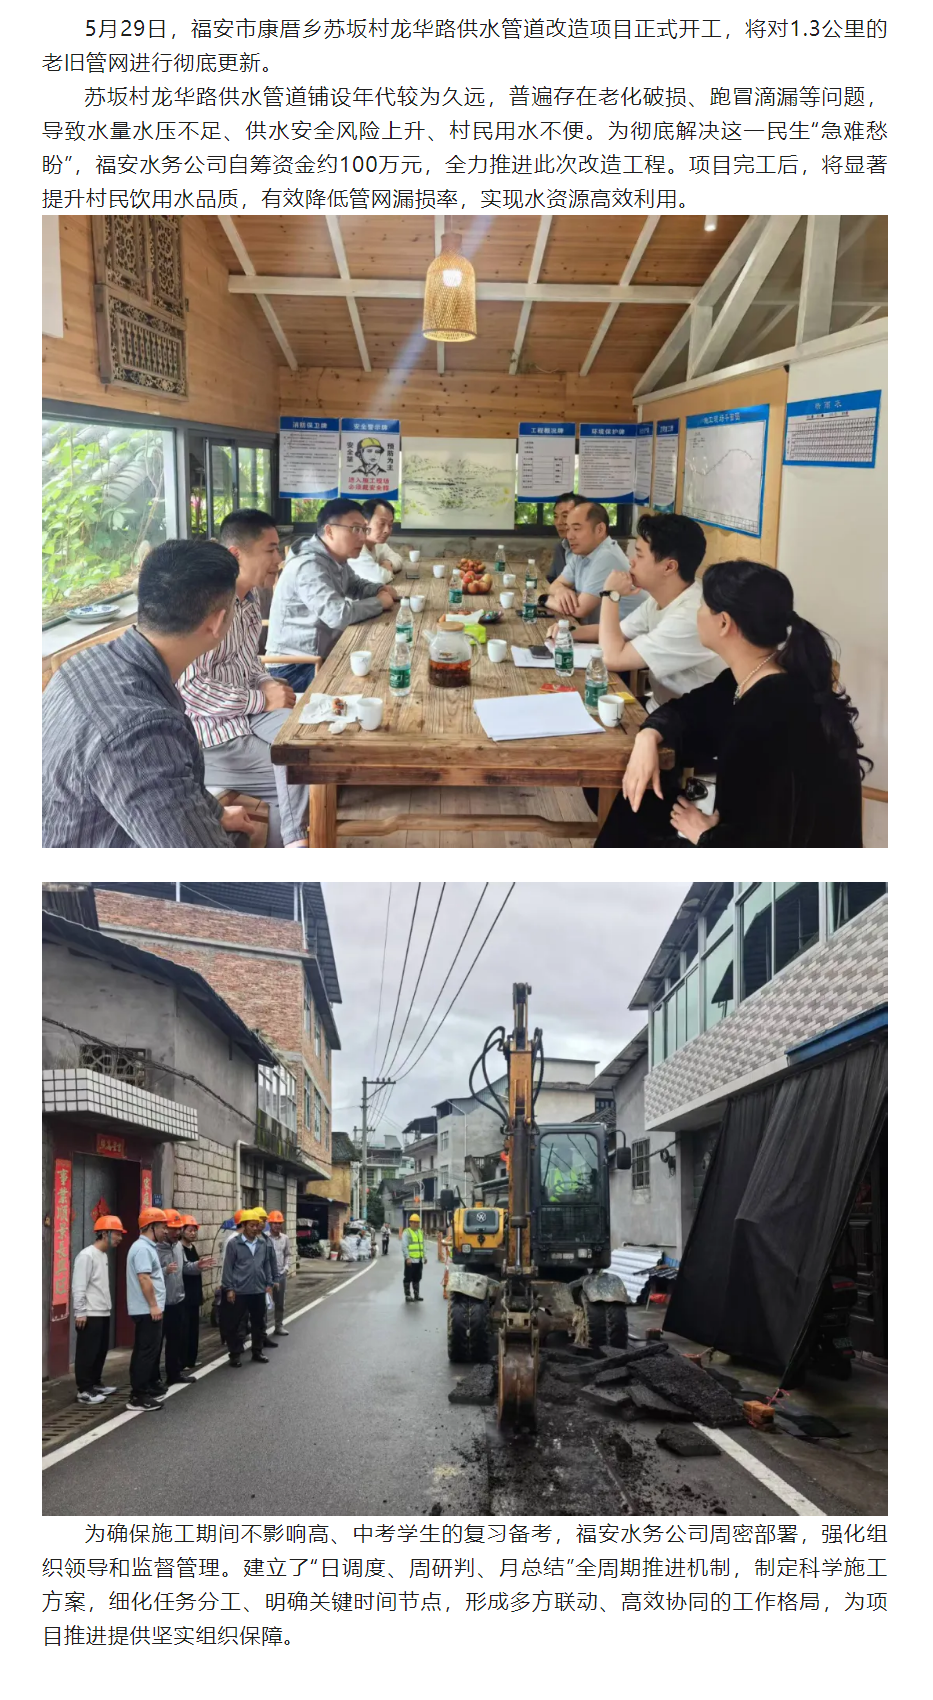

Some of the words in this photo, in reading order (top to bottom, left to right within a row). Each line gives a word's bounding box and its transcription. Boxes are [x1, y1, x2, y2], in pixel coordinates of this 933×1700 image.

[292, 421, 328, 429] 消防保卫牌
[353, 423, 389, 431] 安全警示牌
[346, 441, 354, 468] 安全第一
[386, 442, 395, 471] 预防为主
